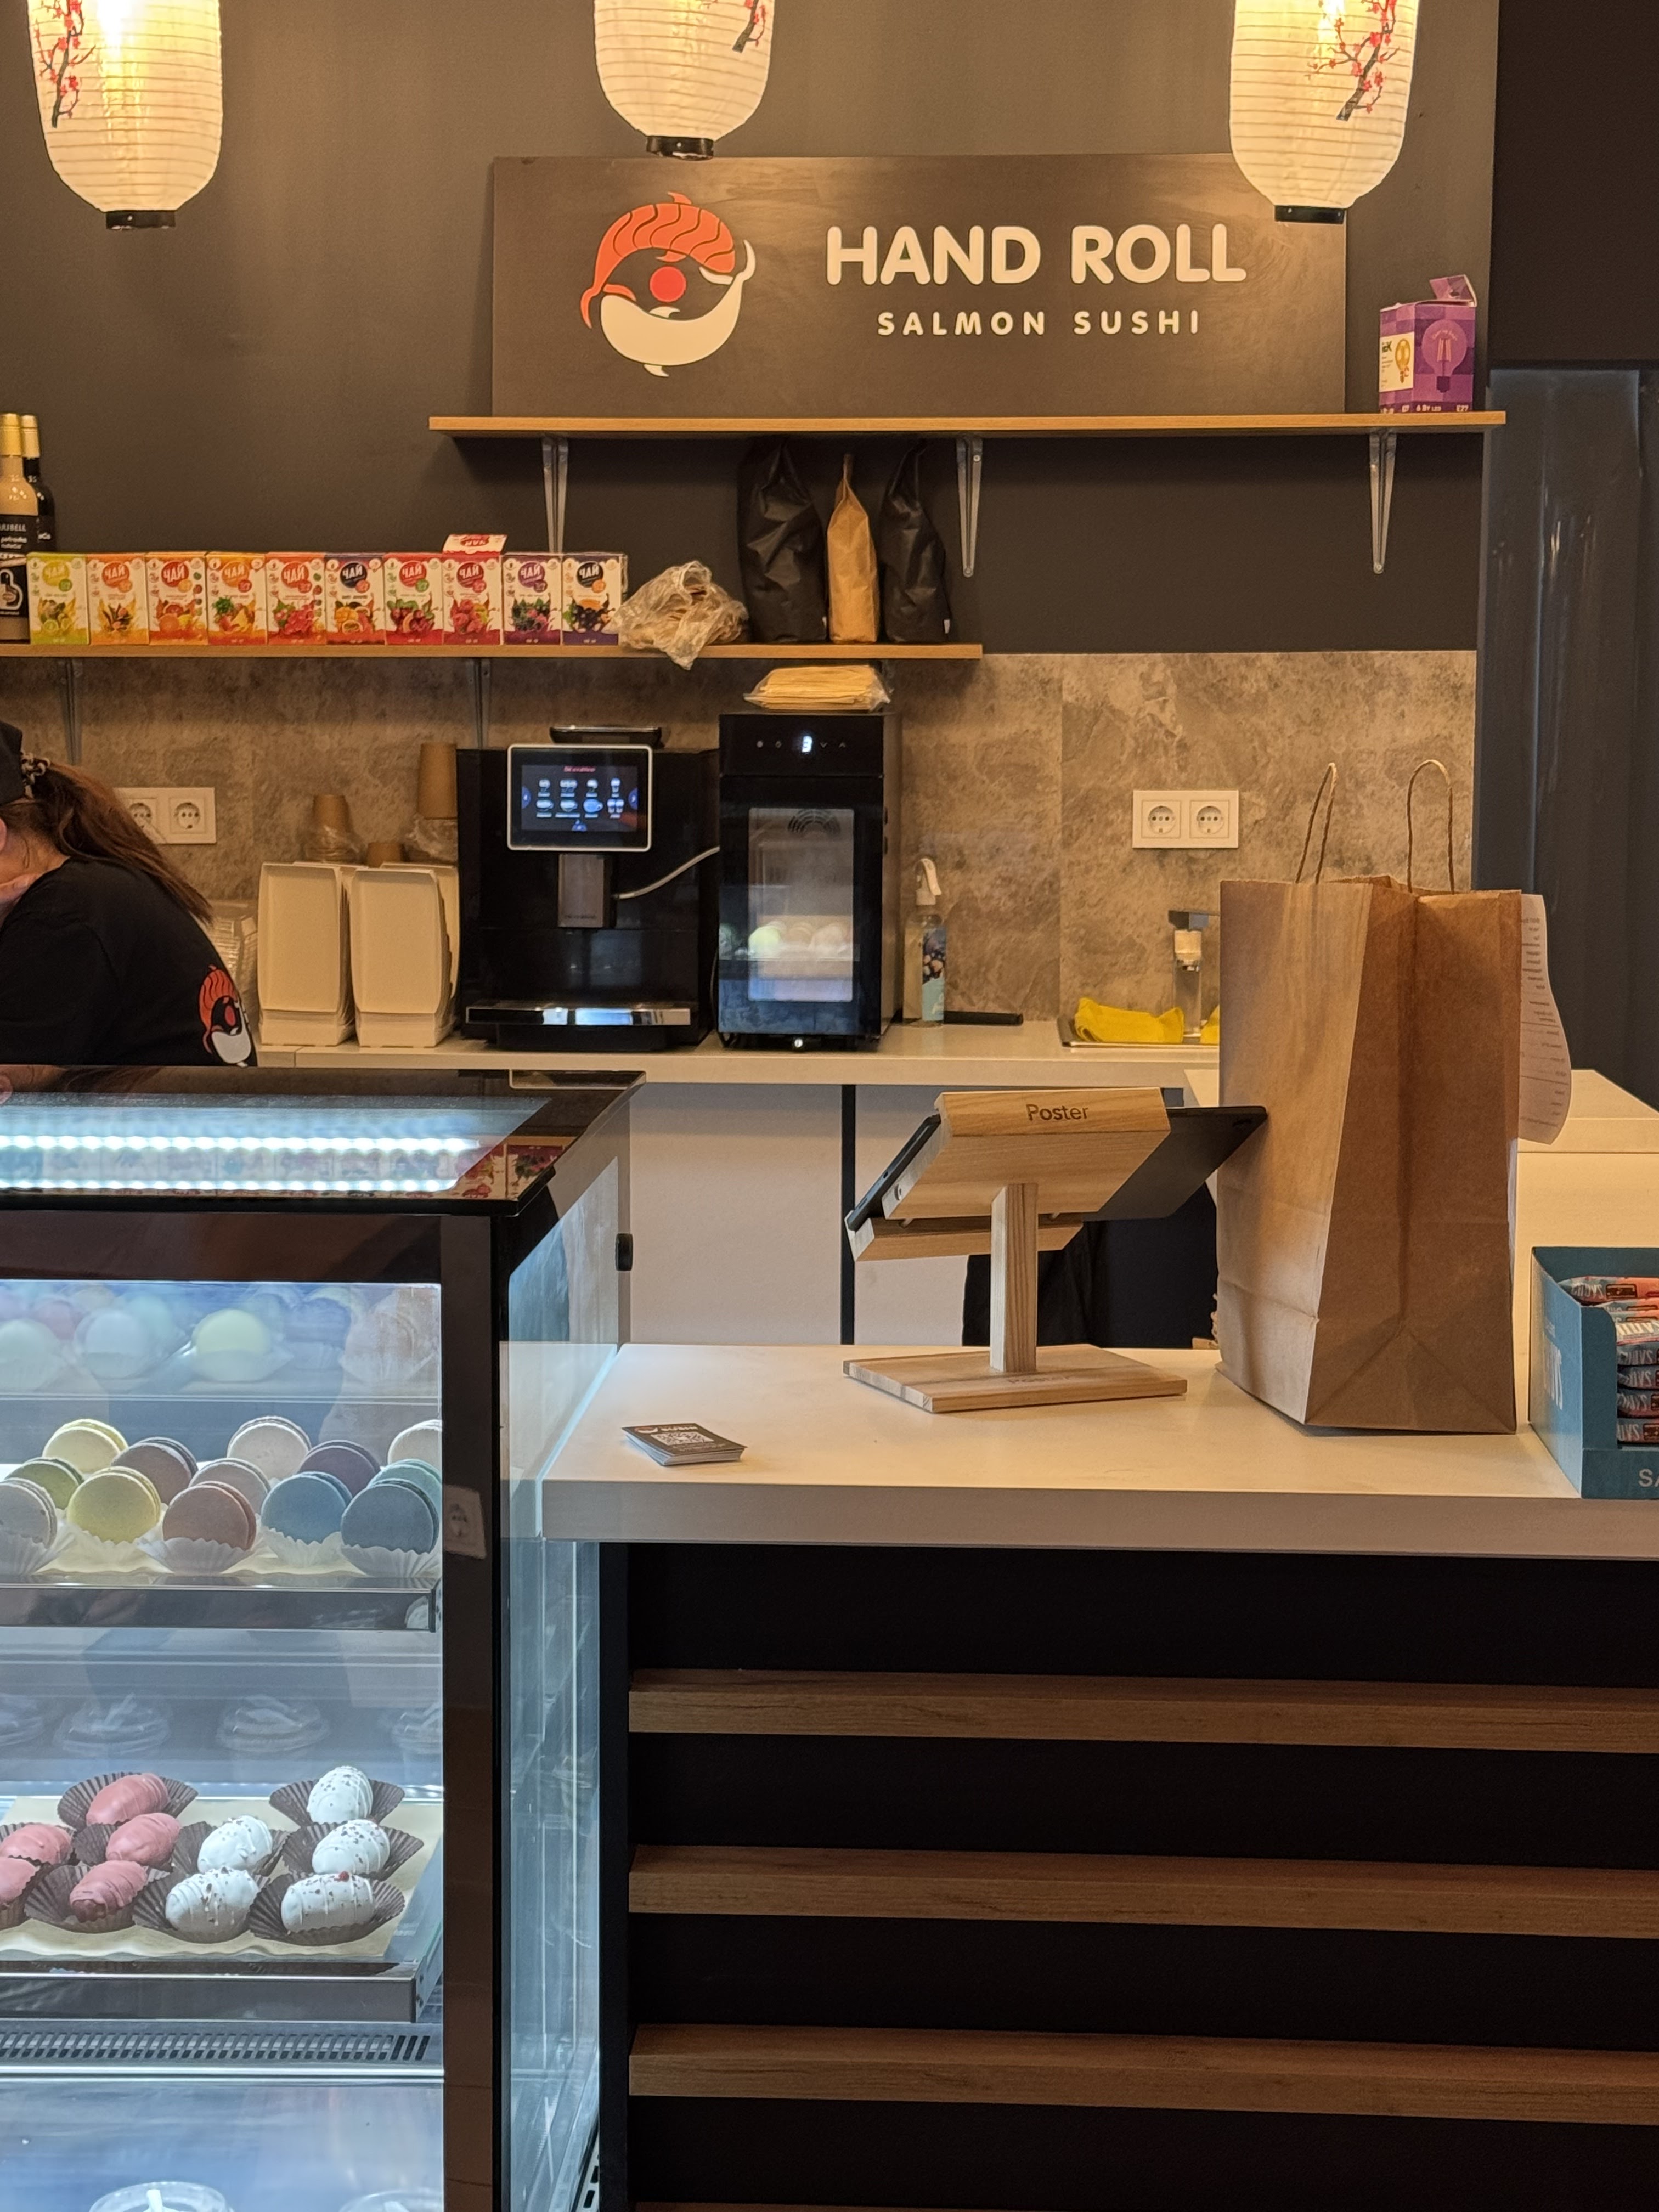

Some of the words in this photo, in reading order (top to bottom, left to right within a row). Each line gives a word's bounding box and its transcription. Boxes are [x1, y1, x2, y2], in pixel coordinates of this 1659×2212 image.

[826, 225, 1041, 286] HAND
[1071, 223, 1248, 284] ROLL
[878, 311, 1045, 336] SALMON
[1073, 310, 1199, 335] SUSHI
[104, 564, 125, 578] ЧАЙ
[163, 564, 185, 583] ЧАЙ
[223, 564, 244, 578] ЧАЙ
[283, 564, 305, 583] ЧАЙ
[342, 565, 363, 580] ЧАЙ
[402, 563, 423, 578] ЧАЙ
[459, 563, 479, 579] ЧАЙ
[520, 565, 541, 578] ЧАЙ
[579, 565, 600, 578] ЧАЙ
[1026, 1103, 1089, 1122] Poster
